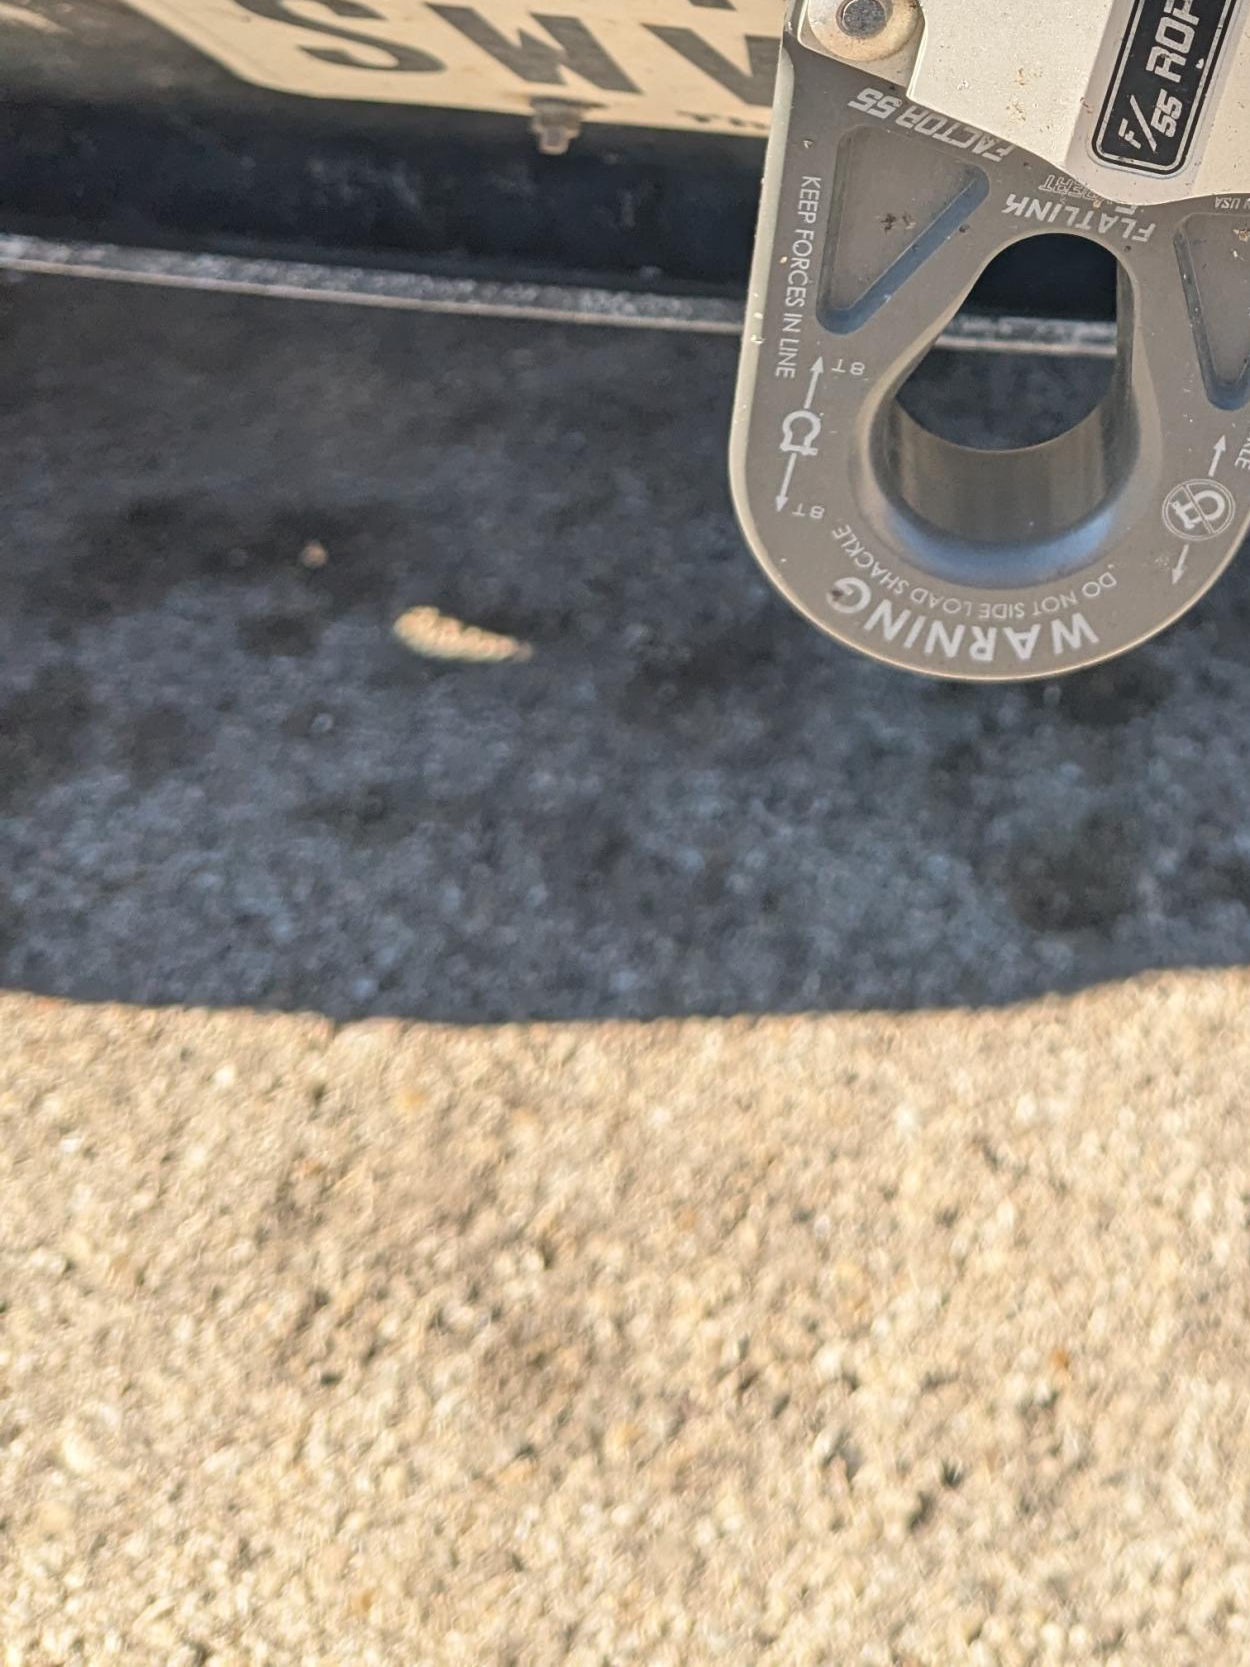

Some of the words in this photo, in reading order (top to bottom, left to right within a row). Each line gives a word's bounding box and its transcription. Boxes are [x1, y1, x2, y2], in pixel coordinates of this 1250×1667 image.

[847, 87, 902, 120] 55
[895, 104, 1016, 162] FACTOR
[796, 175, 822, 224] KEEP
[1000, 193, 1157, 243] FLATLINK
[1213, 196, 1241, 210] USA
[785, 228, 815, 312] FORCES
[781, 312, 802, 333] IN
[775, 337, 800, 379] LINE
[831, 524, 910, 596] SHACKLE
[909, 587, 973, 617] LOAD
[1081, 571, 1118, 598] DO
[825, 576, 1100, 662] WARNING
[978, 601, 1026, 620] SIDE
[1031, 590, 1079, 617] NOT
